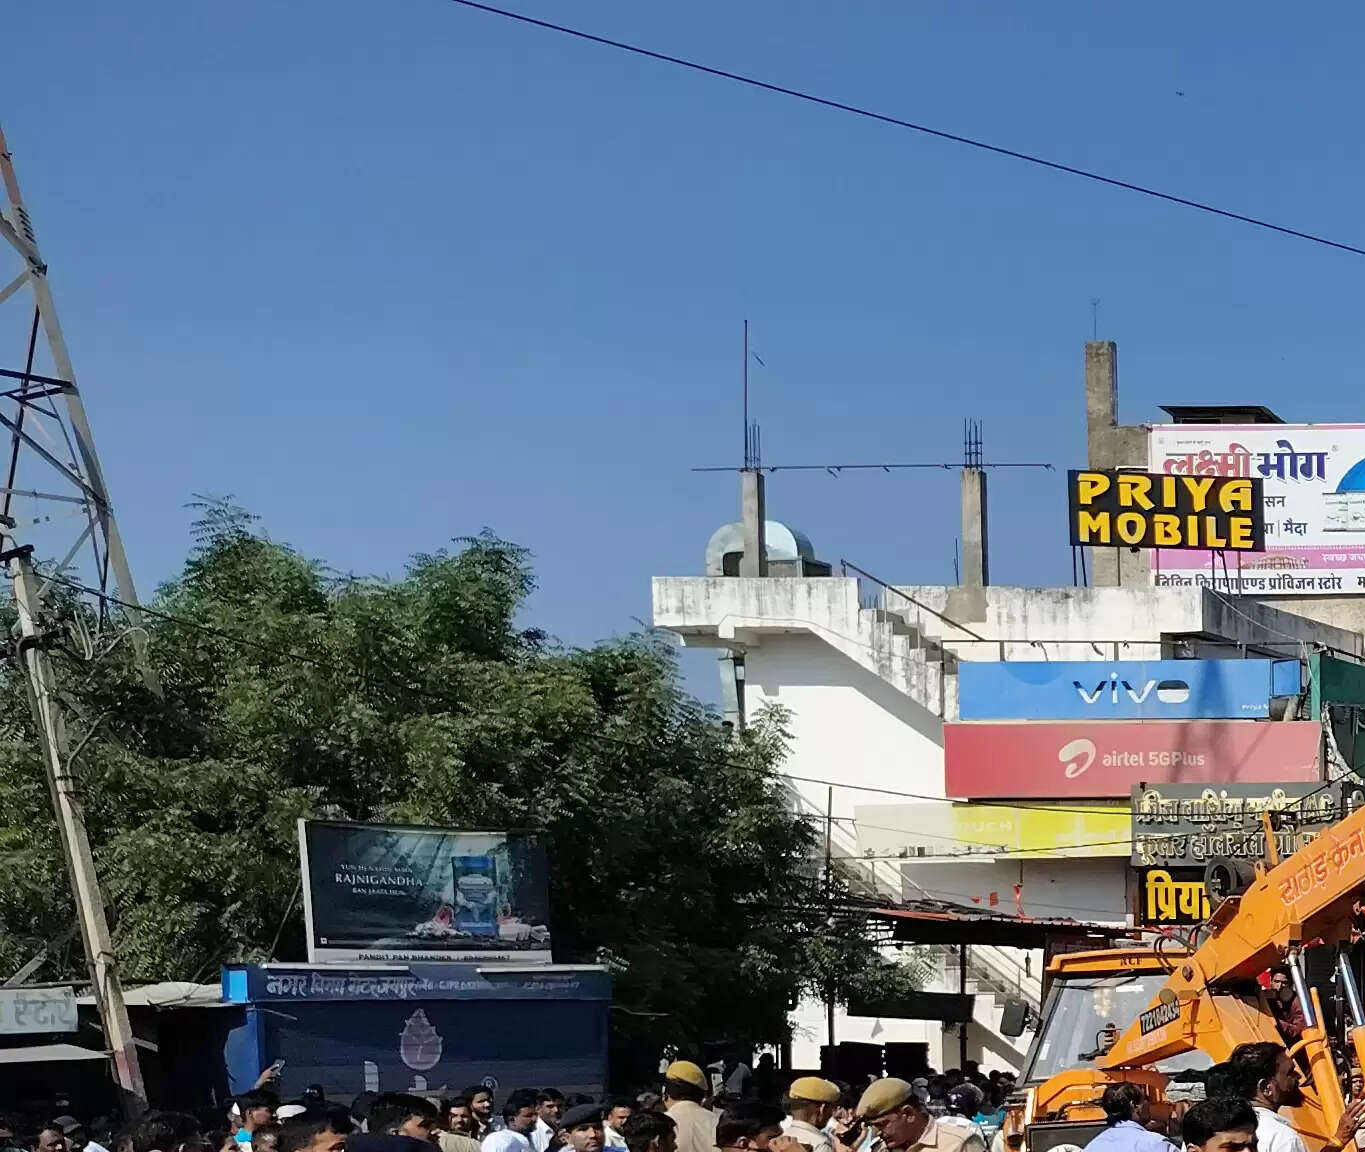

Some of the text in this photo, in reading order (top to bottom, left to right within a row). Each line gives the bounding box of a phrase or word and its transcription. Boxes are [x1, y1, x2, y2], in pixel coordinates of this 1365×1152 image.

[1257, 440, 1328, 480] भोग
[1077, 473, 1252, 513] PRIYA
[1079, 511, 1255, 549] MOBILE
[1283, 518, 1308, 536] मैदा
[1318, 573, 1342, 590] स्टोर
[1072, 672, 1190, 704] vivo
[1102, 751, 1145, 767] airtel
[335, 872, 423, 889] RAJNIGANDHA
